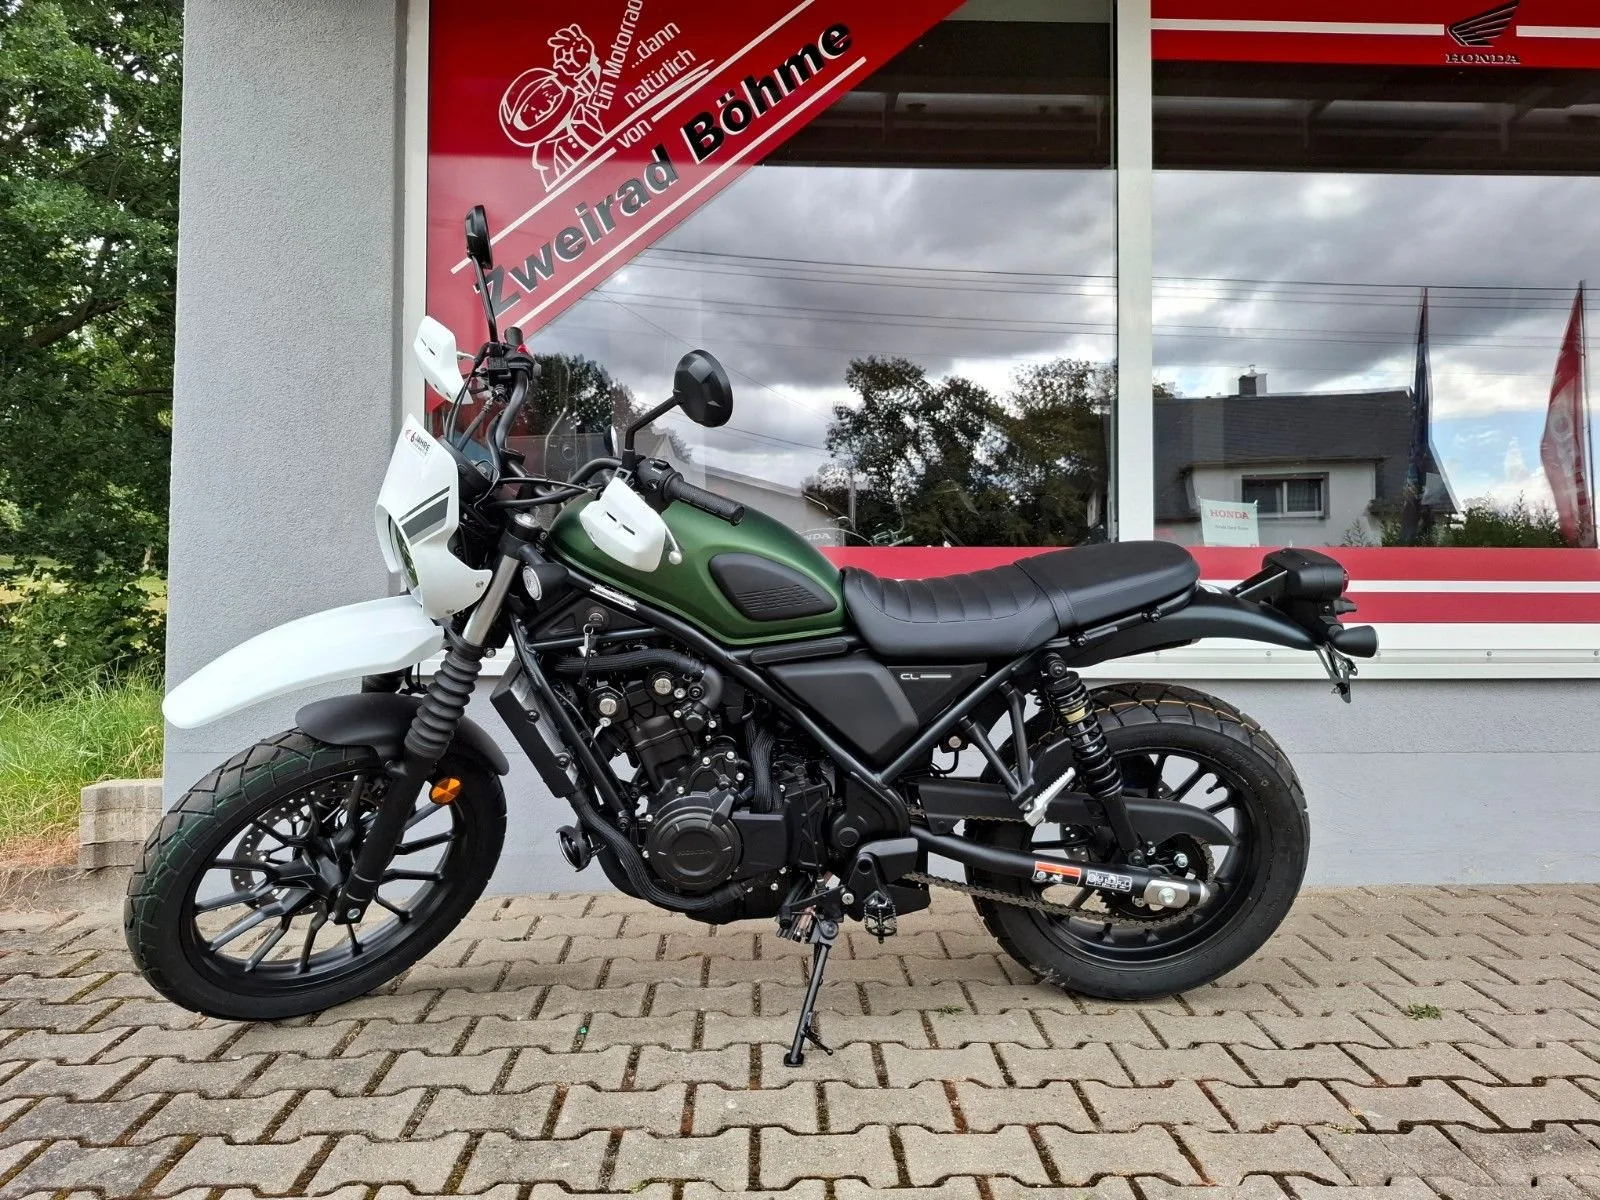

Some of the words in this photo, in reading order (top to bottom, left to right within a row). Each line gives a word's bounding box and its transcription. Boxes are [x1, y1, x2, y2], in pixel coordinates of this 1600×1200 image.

[1445, 53, 1521, 65] HONDA
[624, 49, 696, 108] natürlich
[592, 81, 616, 110] Ein
[617, 119, 652, 148] von
[473, 144, 680, 318] Zweirad
[680, 22, 853, 165] Böhme
[1209, 509, 1249, 520] HONDA
